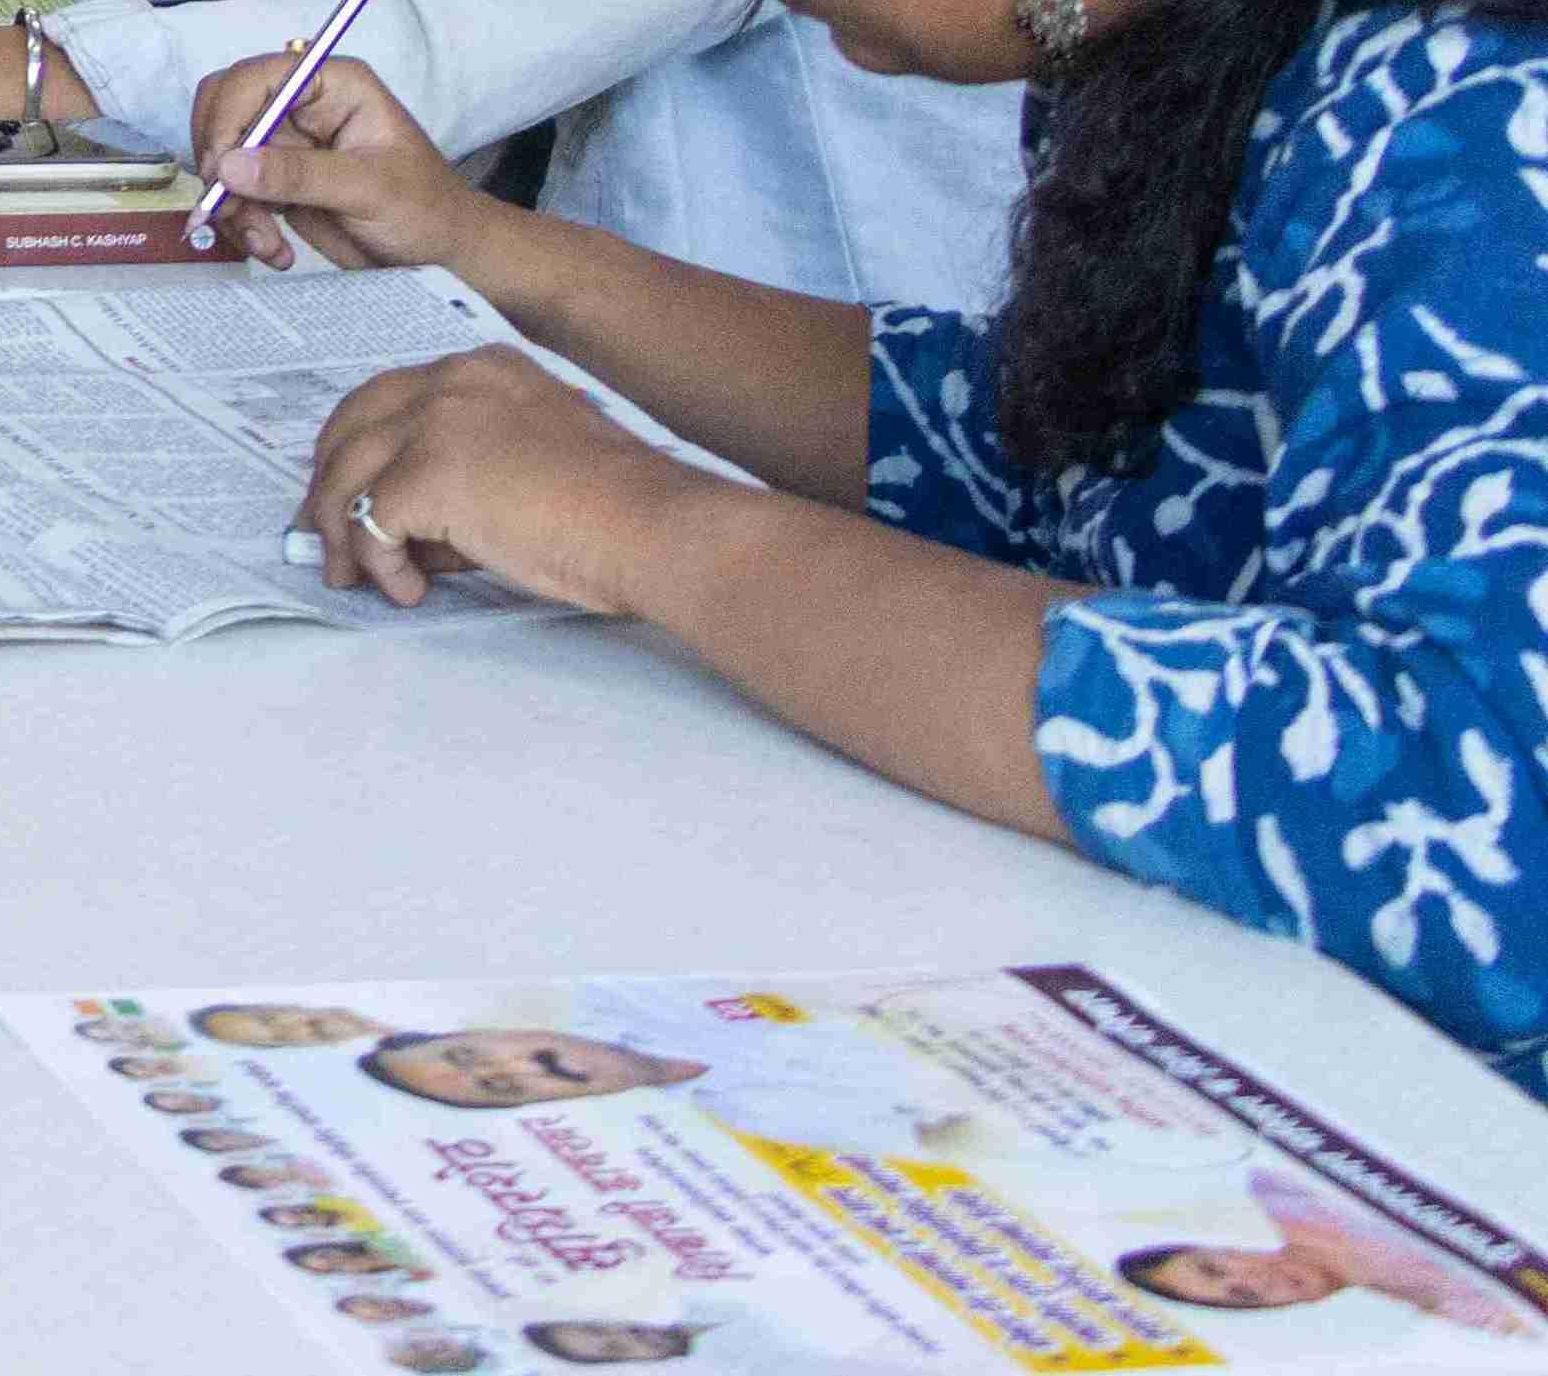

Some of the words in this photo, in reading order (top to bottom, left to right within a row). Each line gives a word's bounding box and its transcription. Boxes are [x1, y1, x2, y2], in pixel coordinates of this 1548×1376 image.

[5, 235, 69, 249] SUBHASH
[71, 235, 84, 248] C.
[87, 232, 147, 248] KASHYAP
